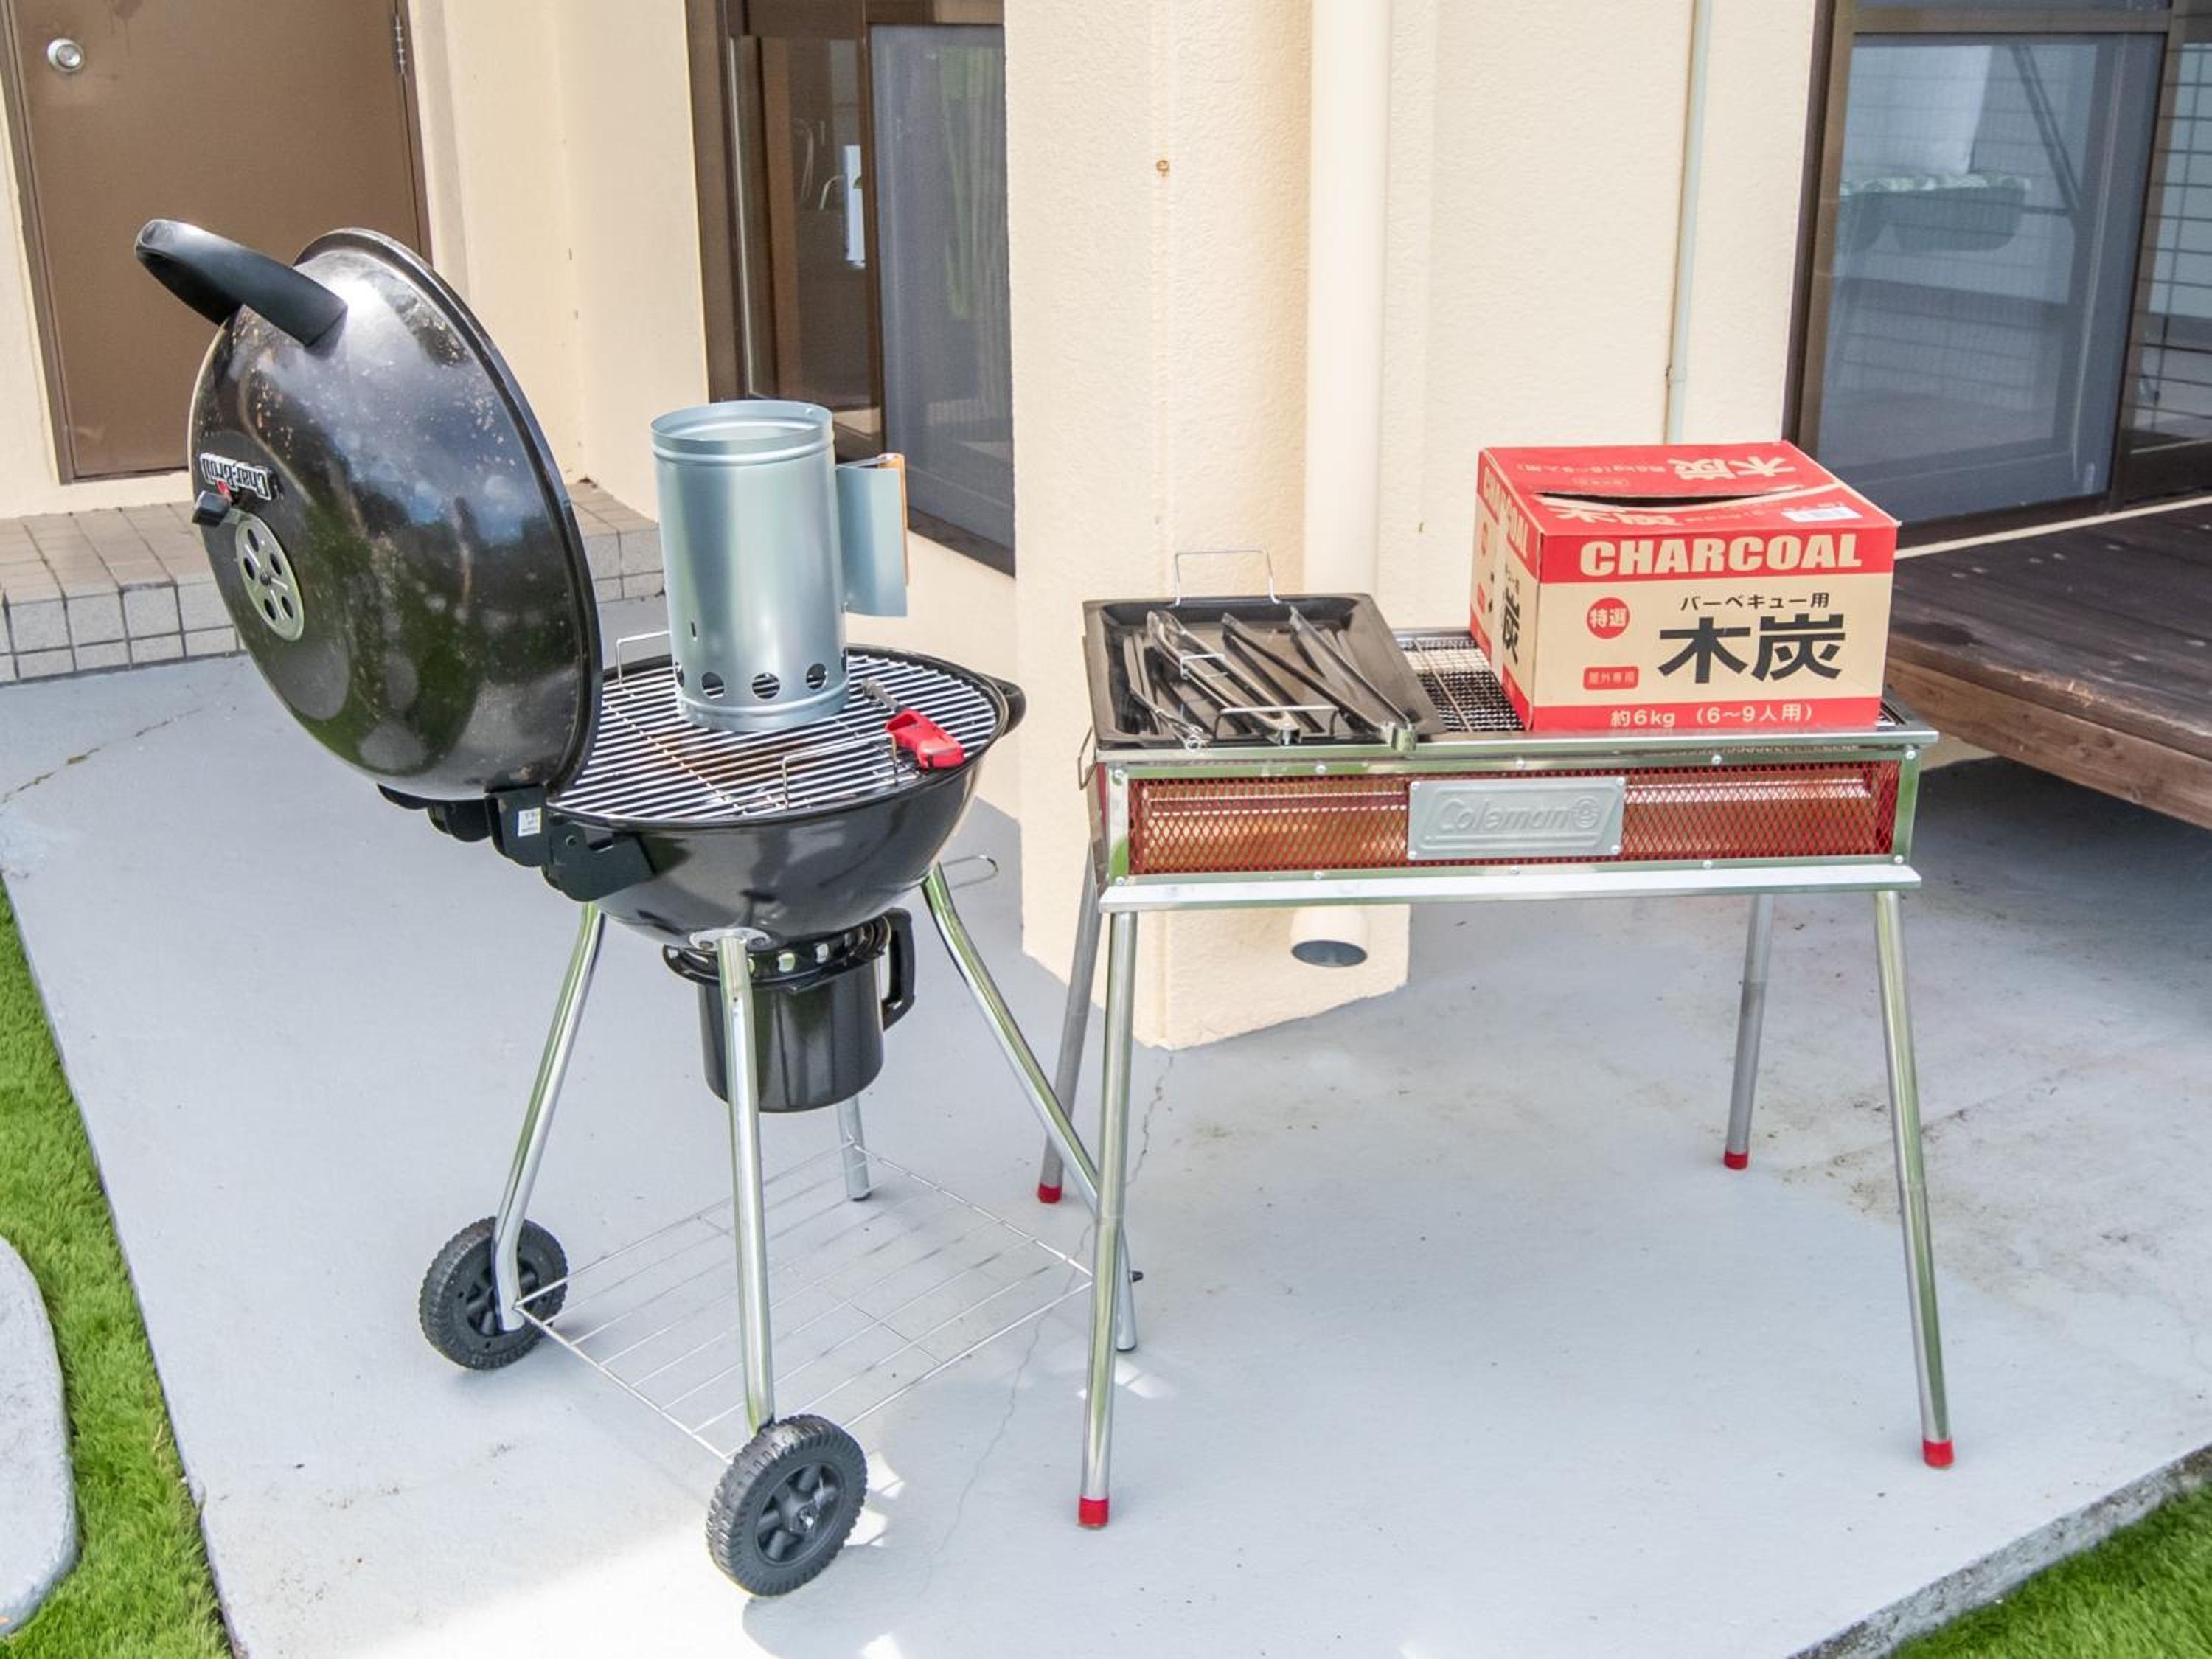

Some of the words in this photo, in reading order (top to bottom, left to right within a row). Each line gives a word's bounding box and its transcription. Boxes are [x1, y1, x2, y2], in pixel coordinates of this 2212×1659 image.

[1580, 534, 1862, 577] CHARCOAL
[1680, 592, 1829, 611] バーベキュー用
[1658, 613, 1846, 684] 木炭
[1610, 709, 1676, 728] 約6kg
[1437, 798, 1571, 832] Coleman
